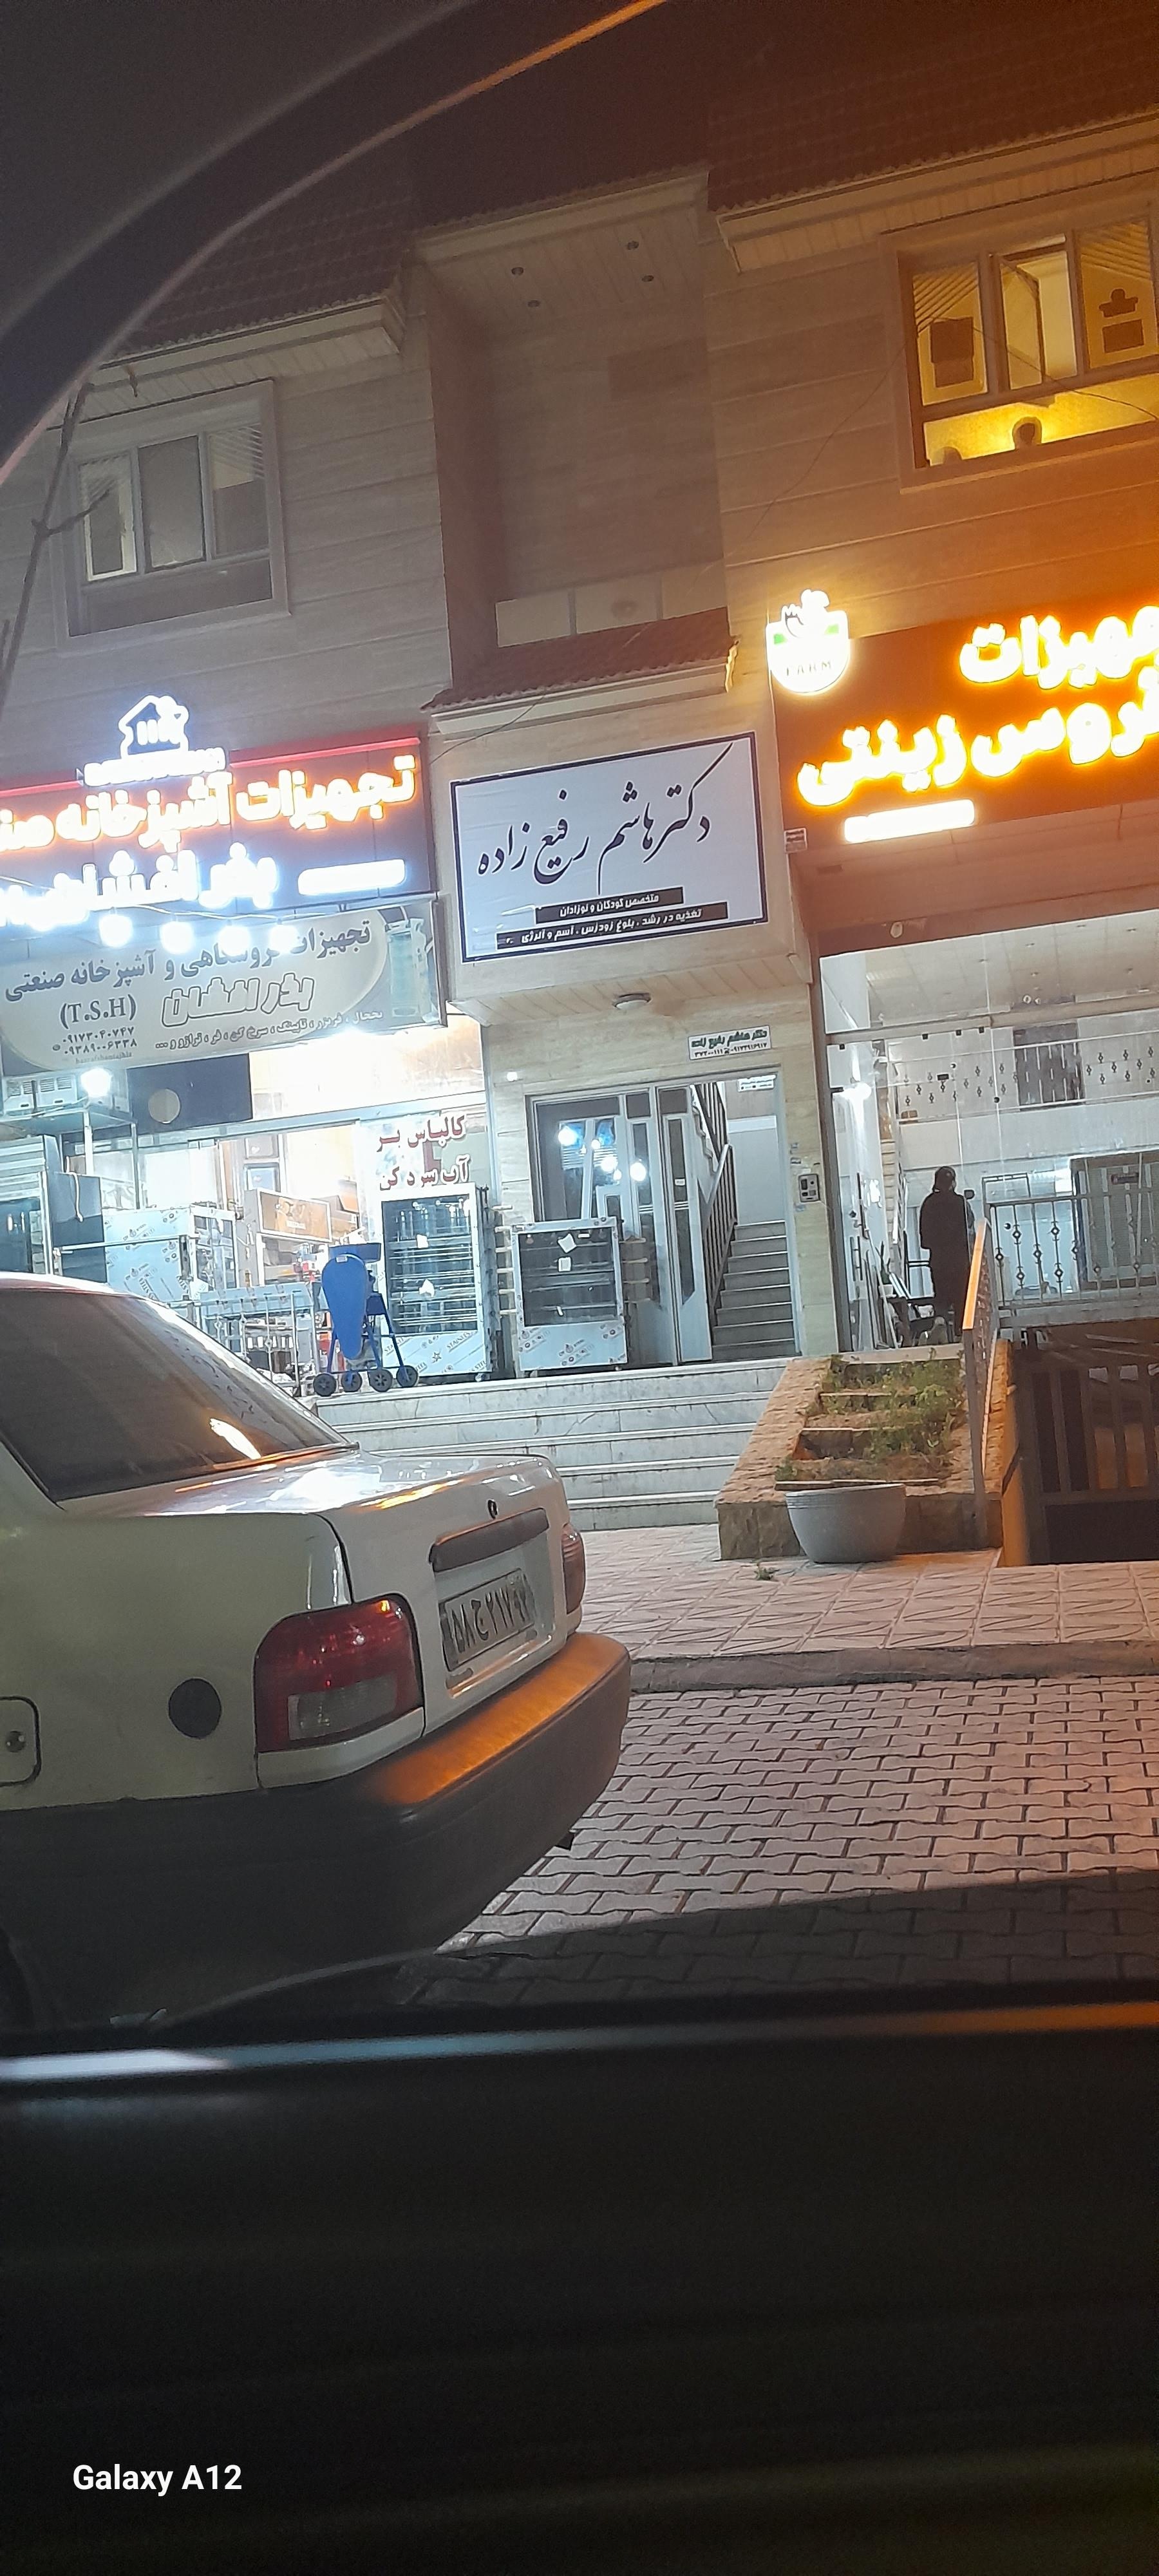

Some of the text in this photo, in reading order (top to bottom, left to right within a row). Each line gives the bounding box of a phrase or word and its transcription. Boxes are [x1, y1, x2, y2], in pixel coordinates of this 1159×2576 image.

[796, 714, 967, 807] زینتی
[236, 755, 416, 830] تجهیزات
[477, 742, 734, 896] دکتر هاشم رفیع زاده
[560, 894, 659, 917] متخصص کودکان و نوزادان
[675, 909, 702, 923] تغذیه
[616, 918, 635, 933] بلوغ
[642, 913, 660, 925] رشد
[663, 914, 674, 923] در
[547, 931, 552, 940] و
[554, 925, 574, 942] آسم
[164, 959, 174, 981] و
[5, 971, 64, 1002] صنعتی
[60, 994, 137, 1029] (T.S.H)
[376, 1115, 465, 1153] کالباس بر
[379, 1166, 400, 1191] کن
[406, 1171, 436, 1188] سرد
